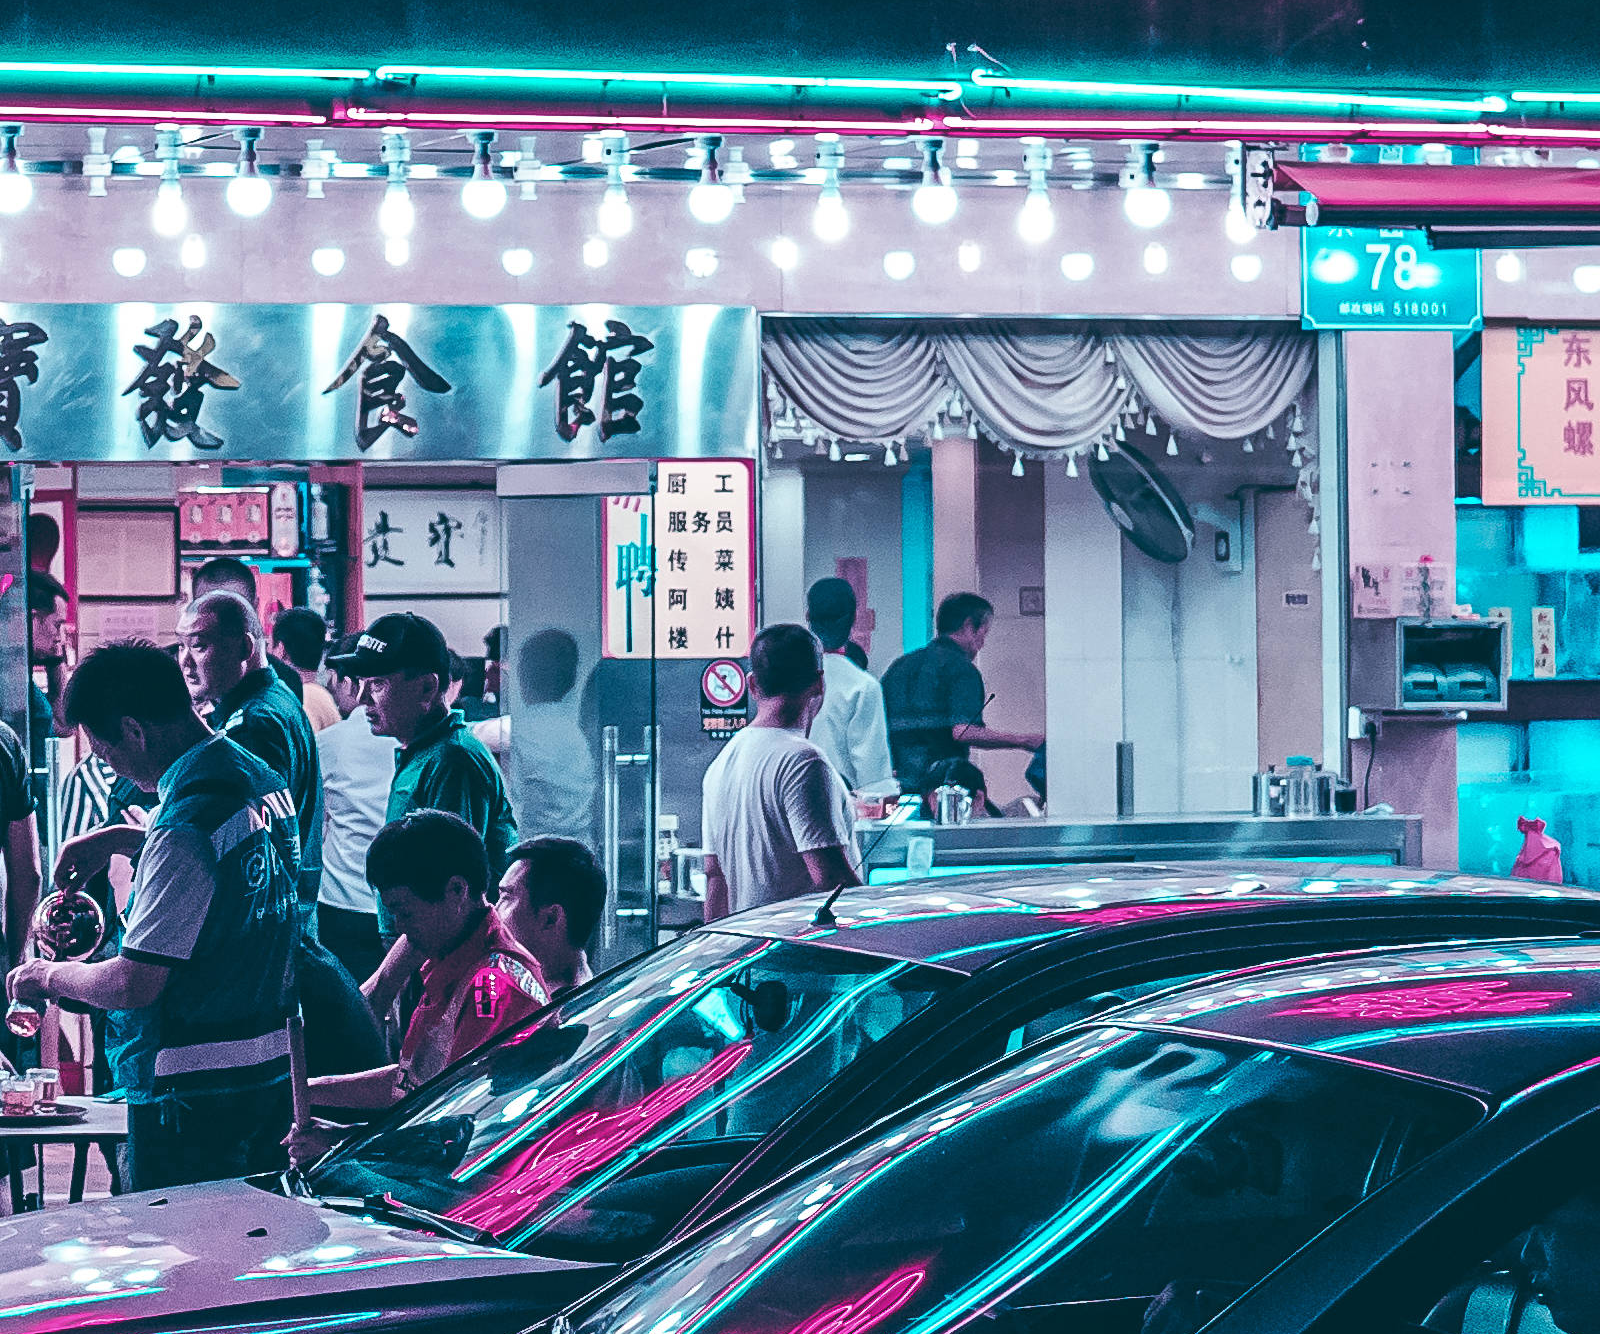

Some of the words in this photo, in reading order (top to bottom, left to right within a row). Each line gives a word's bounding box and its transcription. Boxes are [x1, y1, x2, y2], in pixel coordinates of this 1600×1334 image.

[1365, 243, 1418, 291] 78
[1392, 301, 1448, 316] 518001
[1562, 332, 1594, 457] 东风螺
[667, 473, 734, 494] 厨工
[667, 511, 733, 533] 服务员
[667, 549, 734, 571] 传菜
[668, 587, 735, 611] 阿姨
